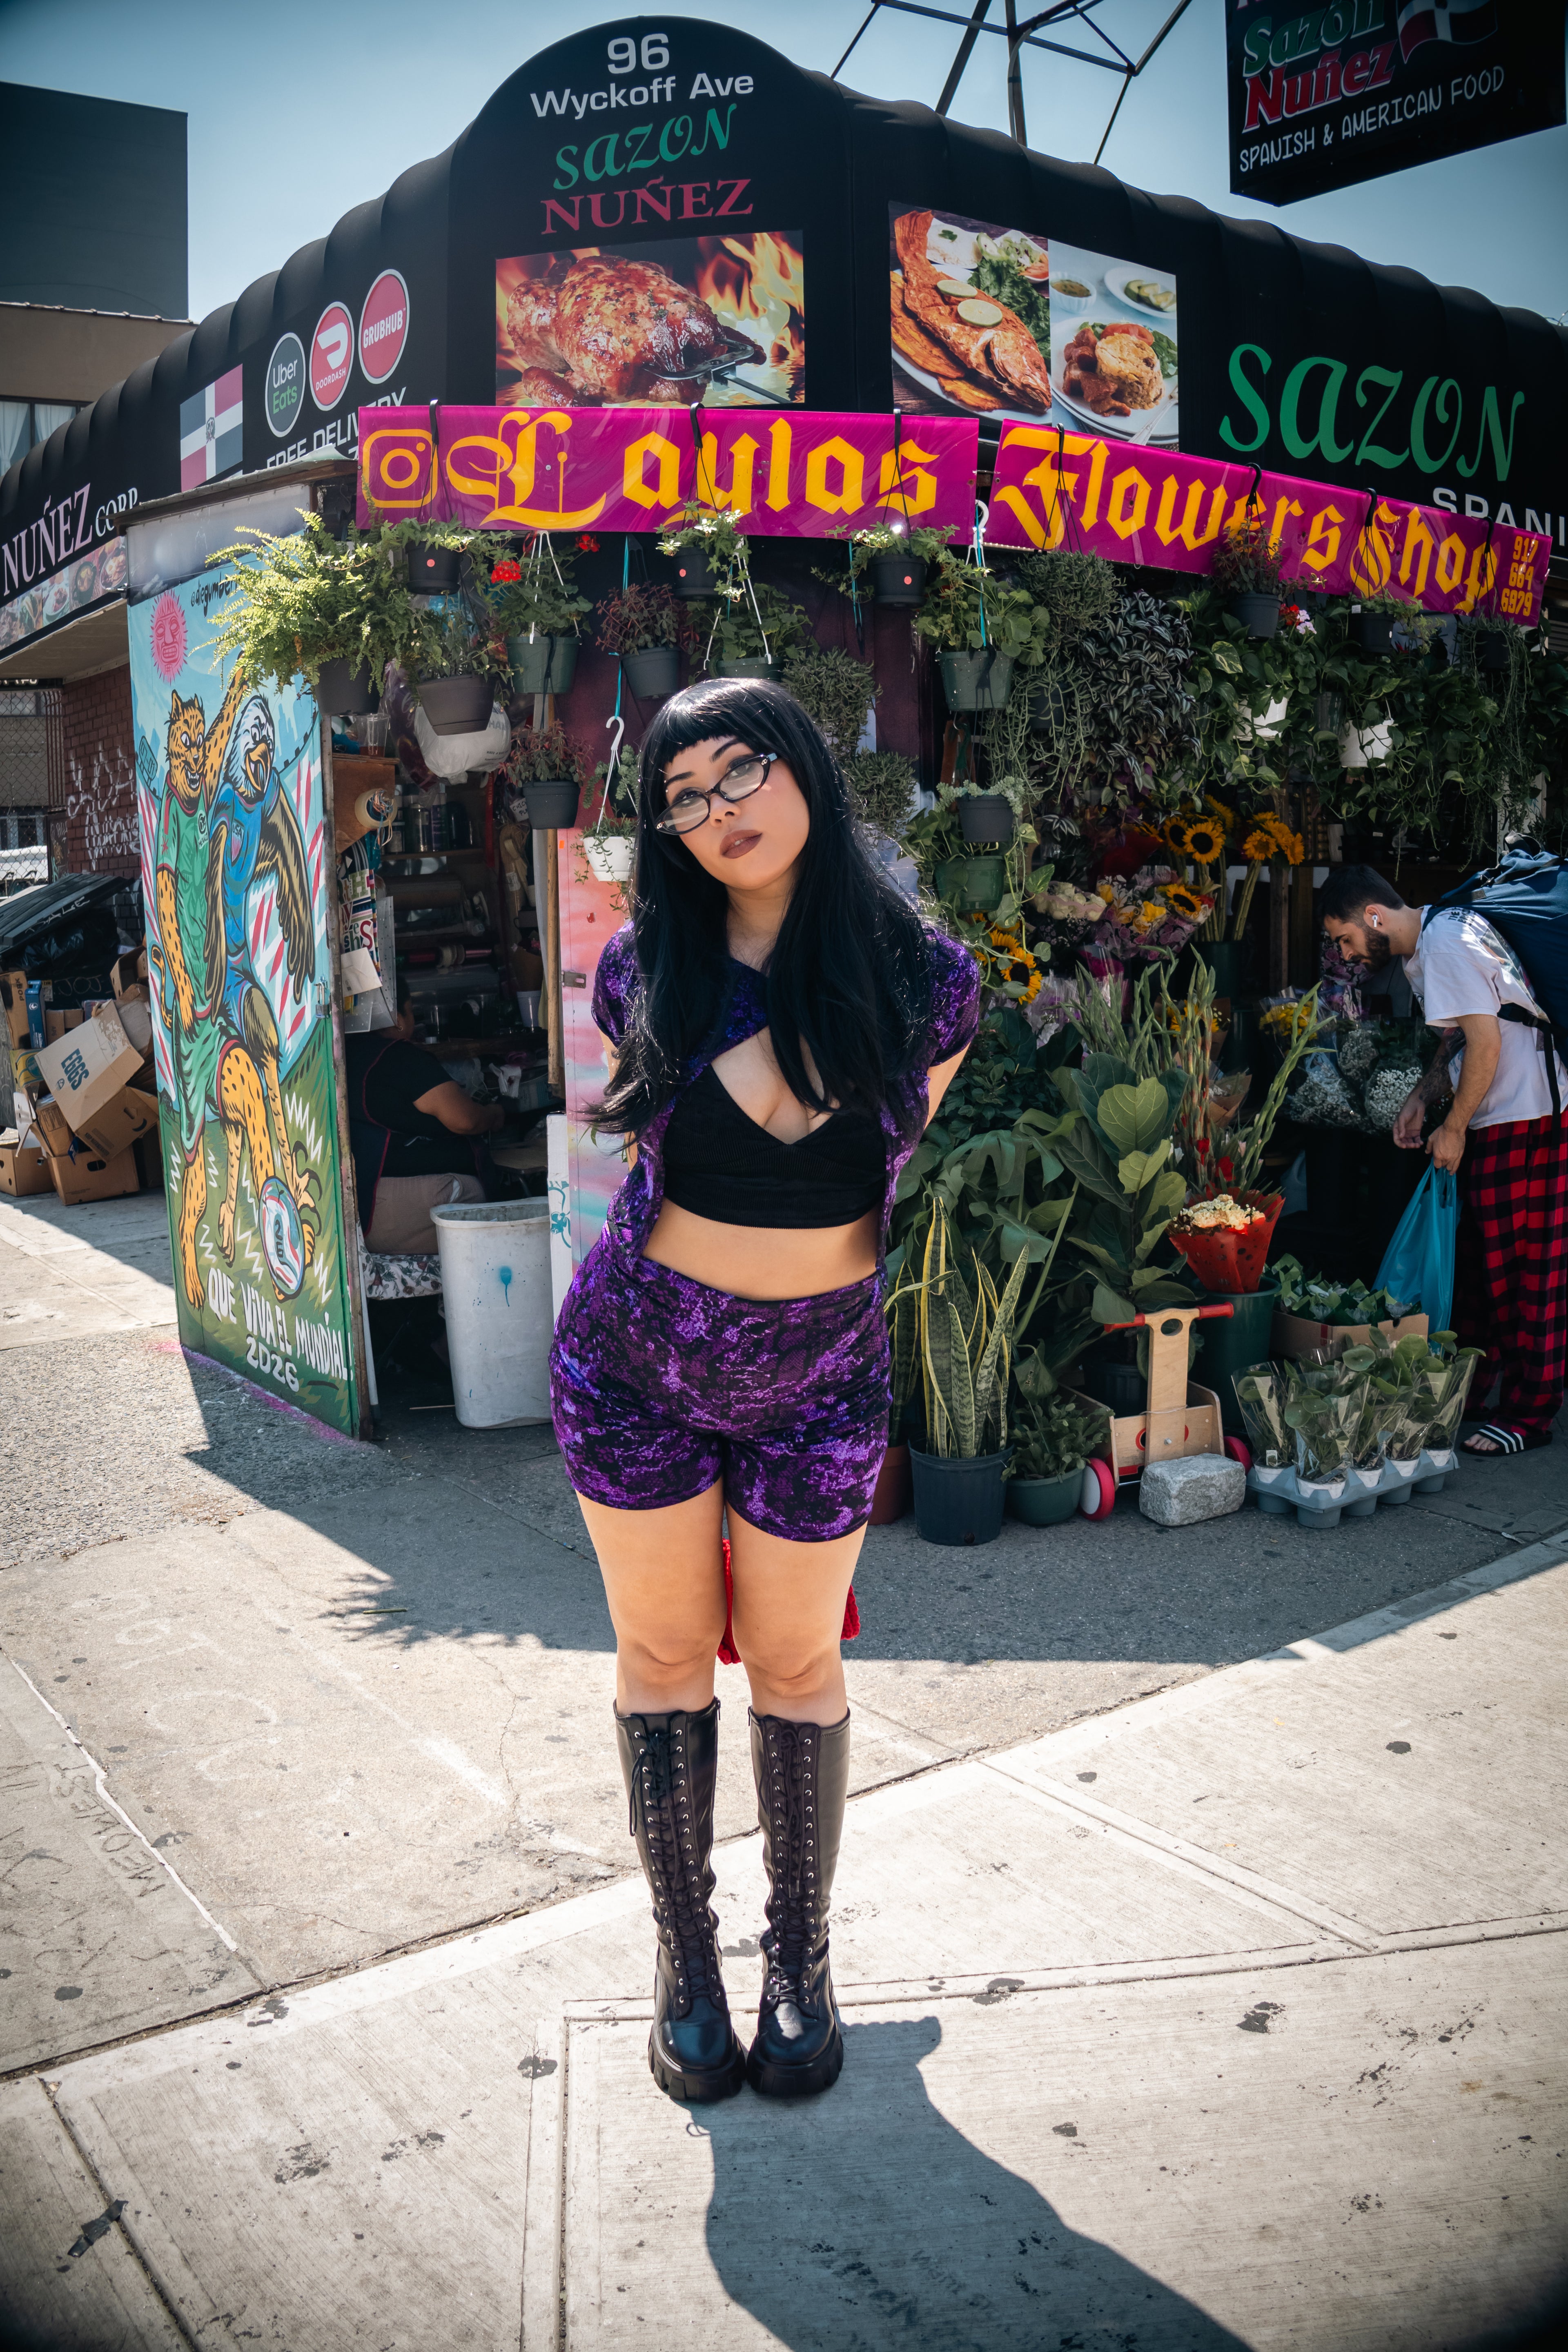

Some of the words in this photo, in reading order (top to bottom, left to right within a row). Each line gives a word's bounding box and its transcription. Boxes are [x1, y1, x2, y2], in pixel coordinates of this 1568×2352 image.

[607, 33, 670, 74] 96
[530, 76, 676, 120] Wyckoff
[689, 72, 754, 100] Ave
[1242, 39, 1398, 134] Nuñez
[1240, 131, 1315, 172] SPANISH
[1323, 124, 1334, 145] &
[1342, 85, 1441, 139] AMERICAN
[1451, 66, 1505, 105] FOOD
[553, 103, 737, 190] SAZON
[540, 175, 754, 235] NUÑEZ
[363, 310, 403, 349] GRUBHUB
[272, 359, 298, 388] Uber
[315, 367, 346, 392] DOORDASH
[272, 385, 298, 415] Eats
[1219, 343, 1525, 481] SAZON
[1432, 487, 1565, 546] SPANI
[2, 482, 93, 597] NUÑEZ
[1350, 501, 1498, 616] Shop
[1512, 535, 1539, 563] 917
[1508, 562, 1535, 590] 664
[1500, 588, 1533, 617] 6979
[198, 832, 209, 846] MEXICO
[232, 823, 243, 842] USA
[61, 1048, 89, 1091] EGGS
[207, 1267, 237, 1324] QUE
[275, 1305, 292, 1356] EL
[246, 1334, 299, 1392] 2026
